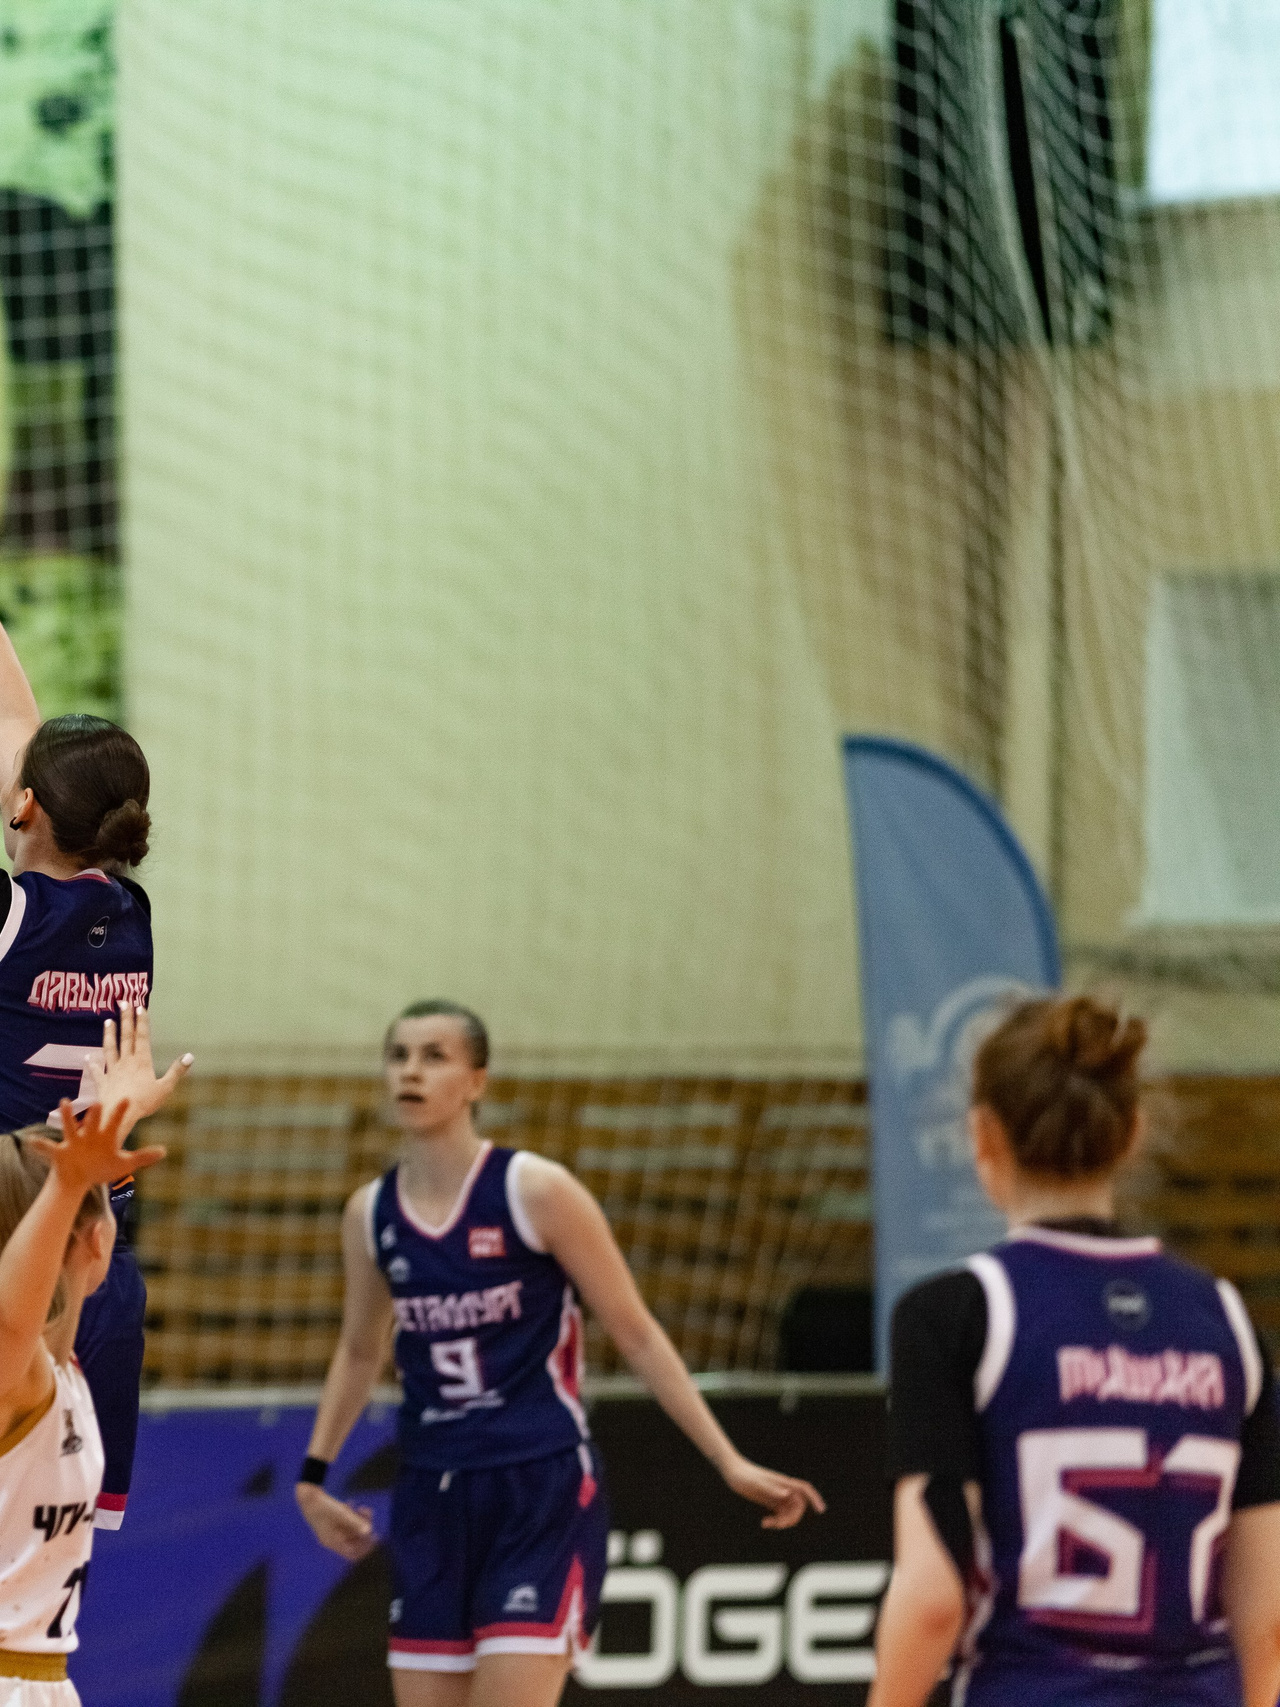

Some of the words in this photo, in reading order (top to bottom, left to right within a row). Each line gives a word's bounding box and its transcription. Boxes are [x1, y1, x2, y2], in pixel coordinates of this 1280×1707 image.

[393, 1280, 523, 1332] ЕТАЛЛУРГ
[429, 1336, 484, 1400] 9
[33, 1502, 94, 1543] ЧГУ-
[1017, 1421, 1242, 1627] 67
[573, 1528, 892, 1690] ÖGE
